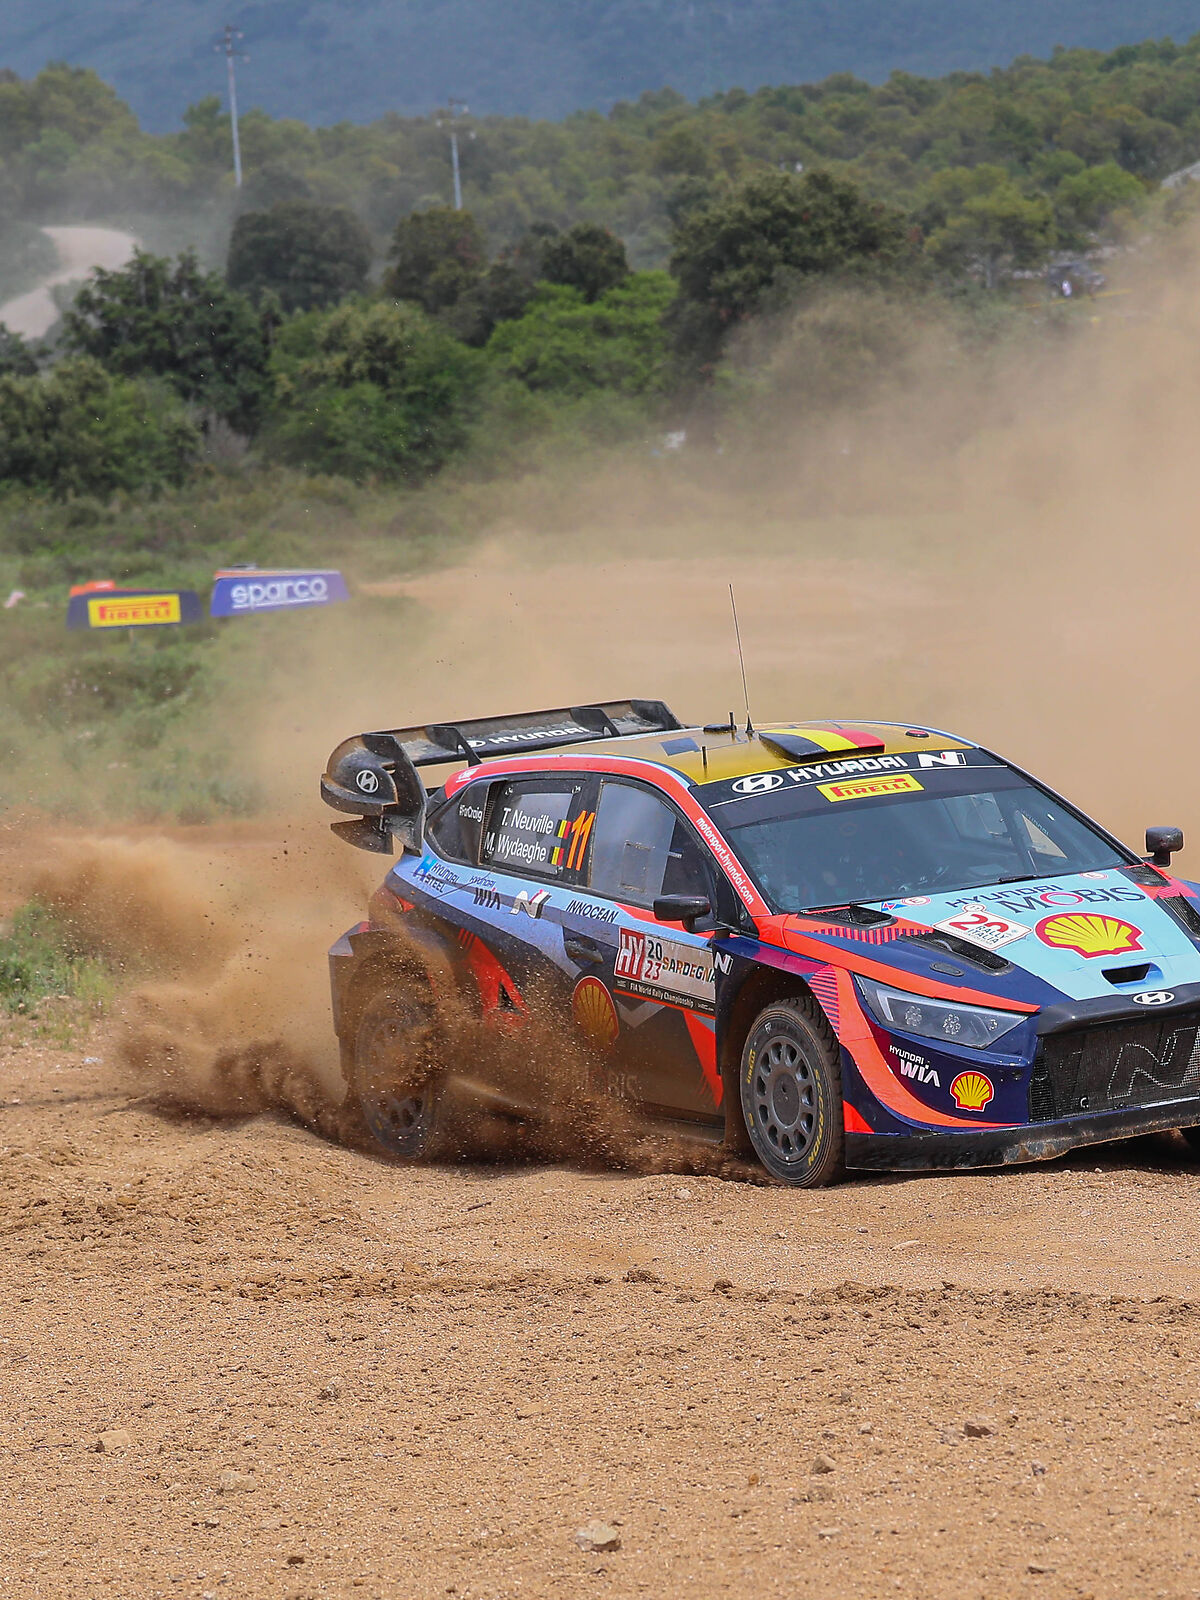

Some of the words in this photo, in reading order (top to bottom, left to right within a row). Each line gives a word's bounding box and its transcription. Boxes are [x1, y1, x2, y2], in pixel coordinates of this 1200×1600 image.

[230, 577, 328, 609] sparco
[98, 601, 170, 620] PIRELLI
[488, 727, 590, 745] HYUNDAI
[787, 755, 909, 783] HYUNDAI
[829, 777, 912, 797] PIRELLI
[501, 807, 512, 827] T.
[511, 809, 554, 835] Neuville
[484, 832, 496, 852] M.
[497, 833, 547, 864] Wydaeghe
[566, 810, 597, 871] 11
[430, 862, 460, 884] HYUNDAI
[696, 817, 755, 905] motorsport.hyundai.com
[424, 873, 446, 893] STEEL
[473, 887, 501, 910] WIA
[945, 884, 1064, 908] HYUNDAI
[995, 886, 1146, 914] MOBIS
[566, 899, 619, 923] INNOCEAN
[967, 929, 1000, 944] ITALIA
[976, 925, 1009, 939] RALLY
[644, 959, 662, 981] 23
[647, 940, 663, 960] 20
[661, 956, 715, 984] SARDEGNA
[630, 982, 640, 993] FIA
[639, 984, 652, 996] World
[889, 1045, 924, 1065] HYUNDAI
[900, 1058, 941, 1088] WIA
[807, 1068, 825, 1167] SCORPION
